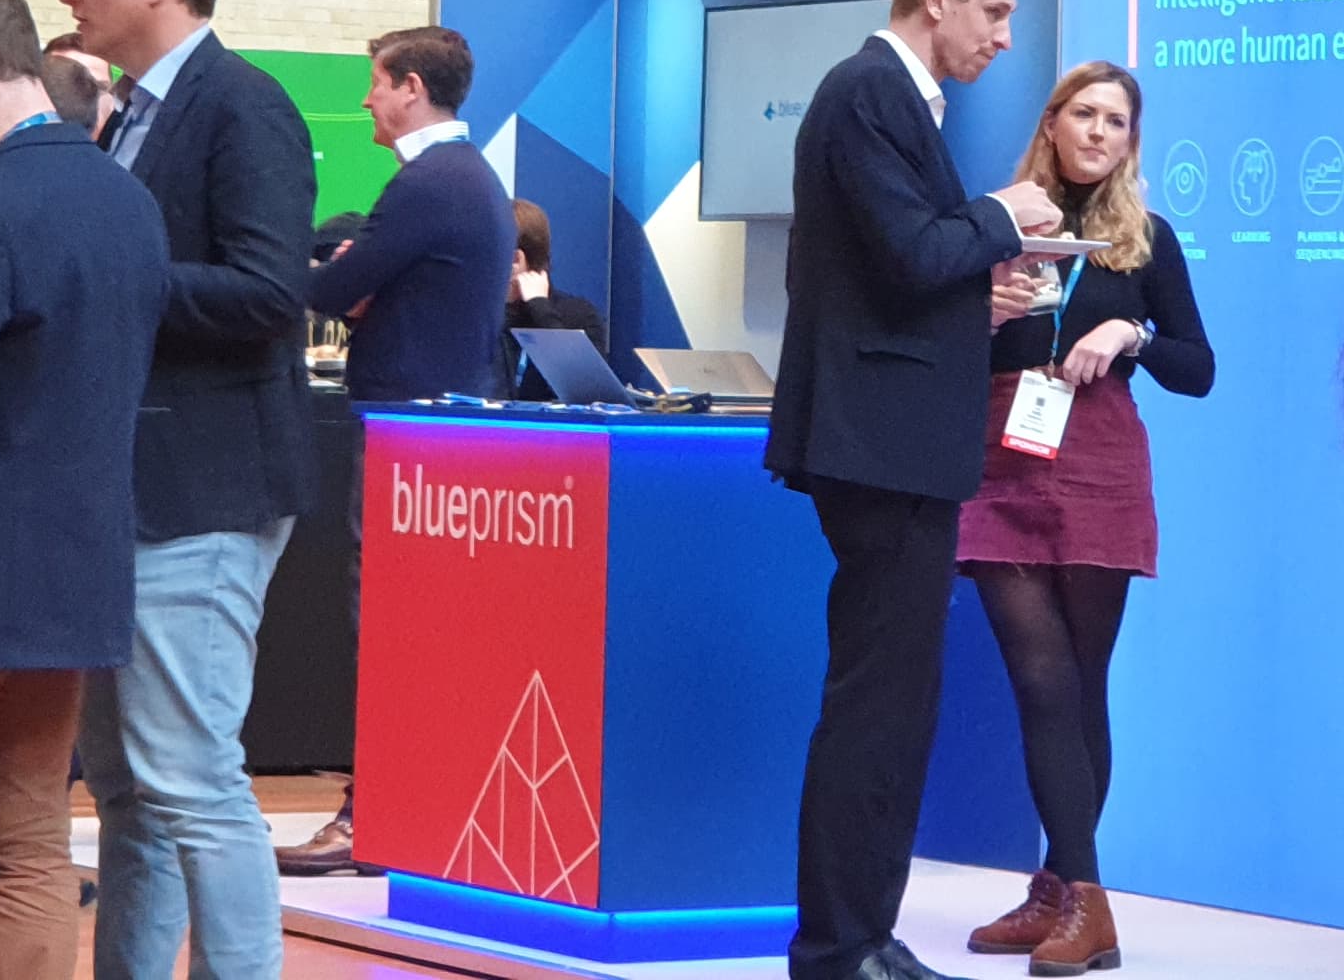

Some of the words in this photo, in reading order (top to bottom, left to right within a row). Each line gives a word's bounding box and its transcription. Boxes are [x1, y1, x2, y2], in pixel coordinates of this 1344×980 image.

[1153, 39, 1169, 68] a
[1173, 36, 1236, 66] more
[1241, 25, 1327, 63] human
